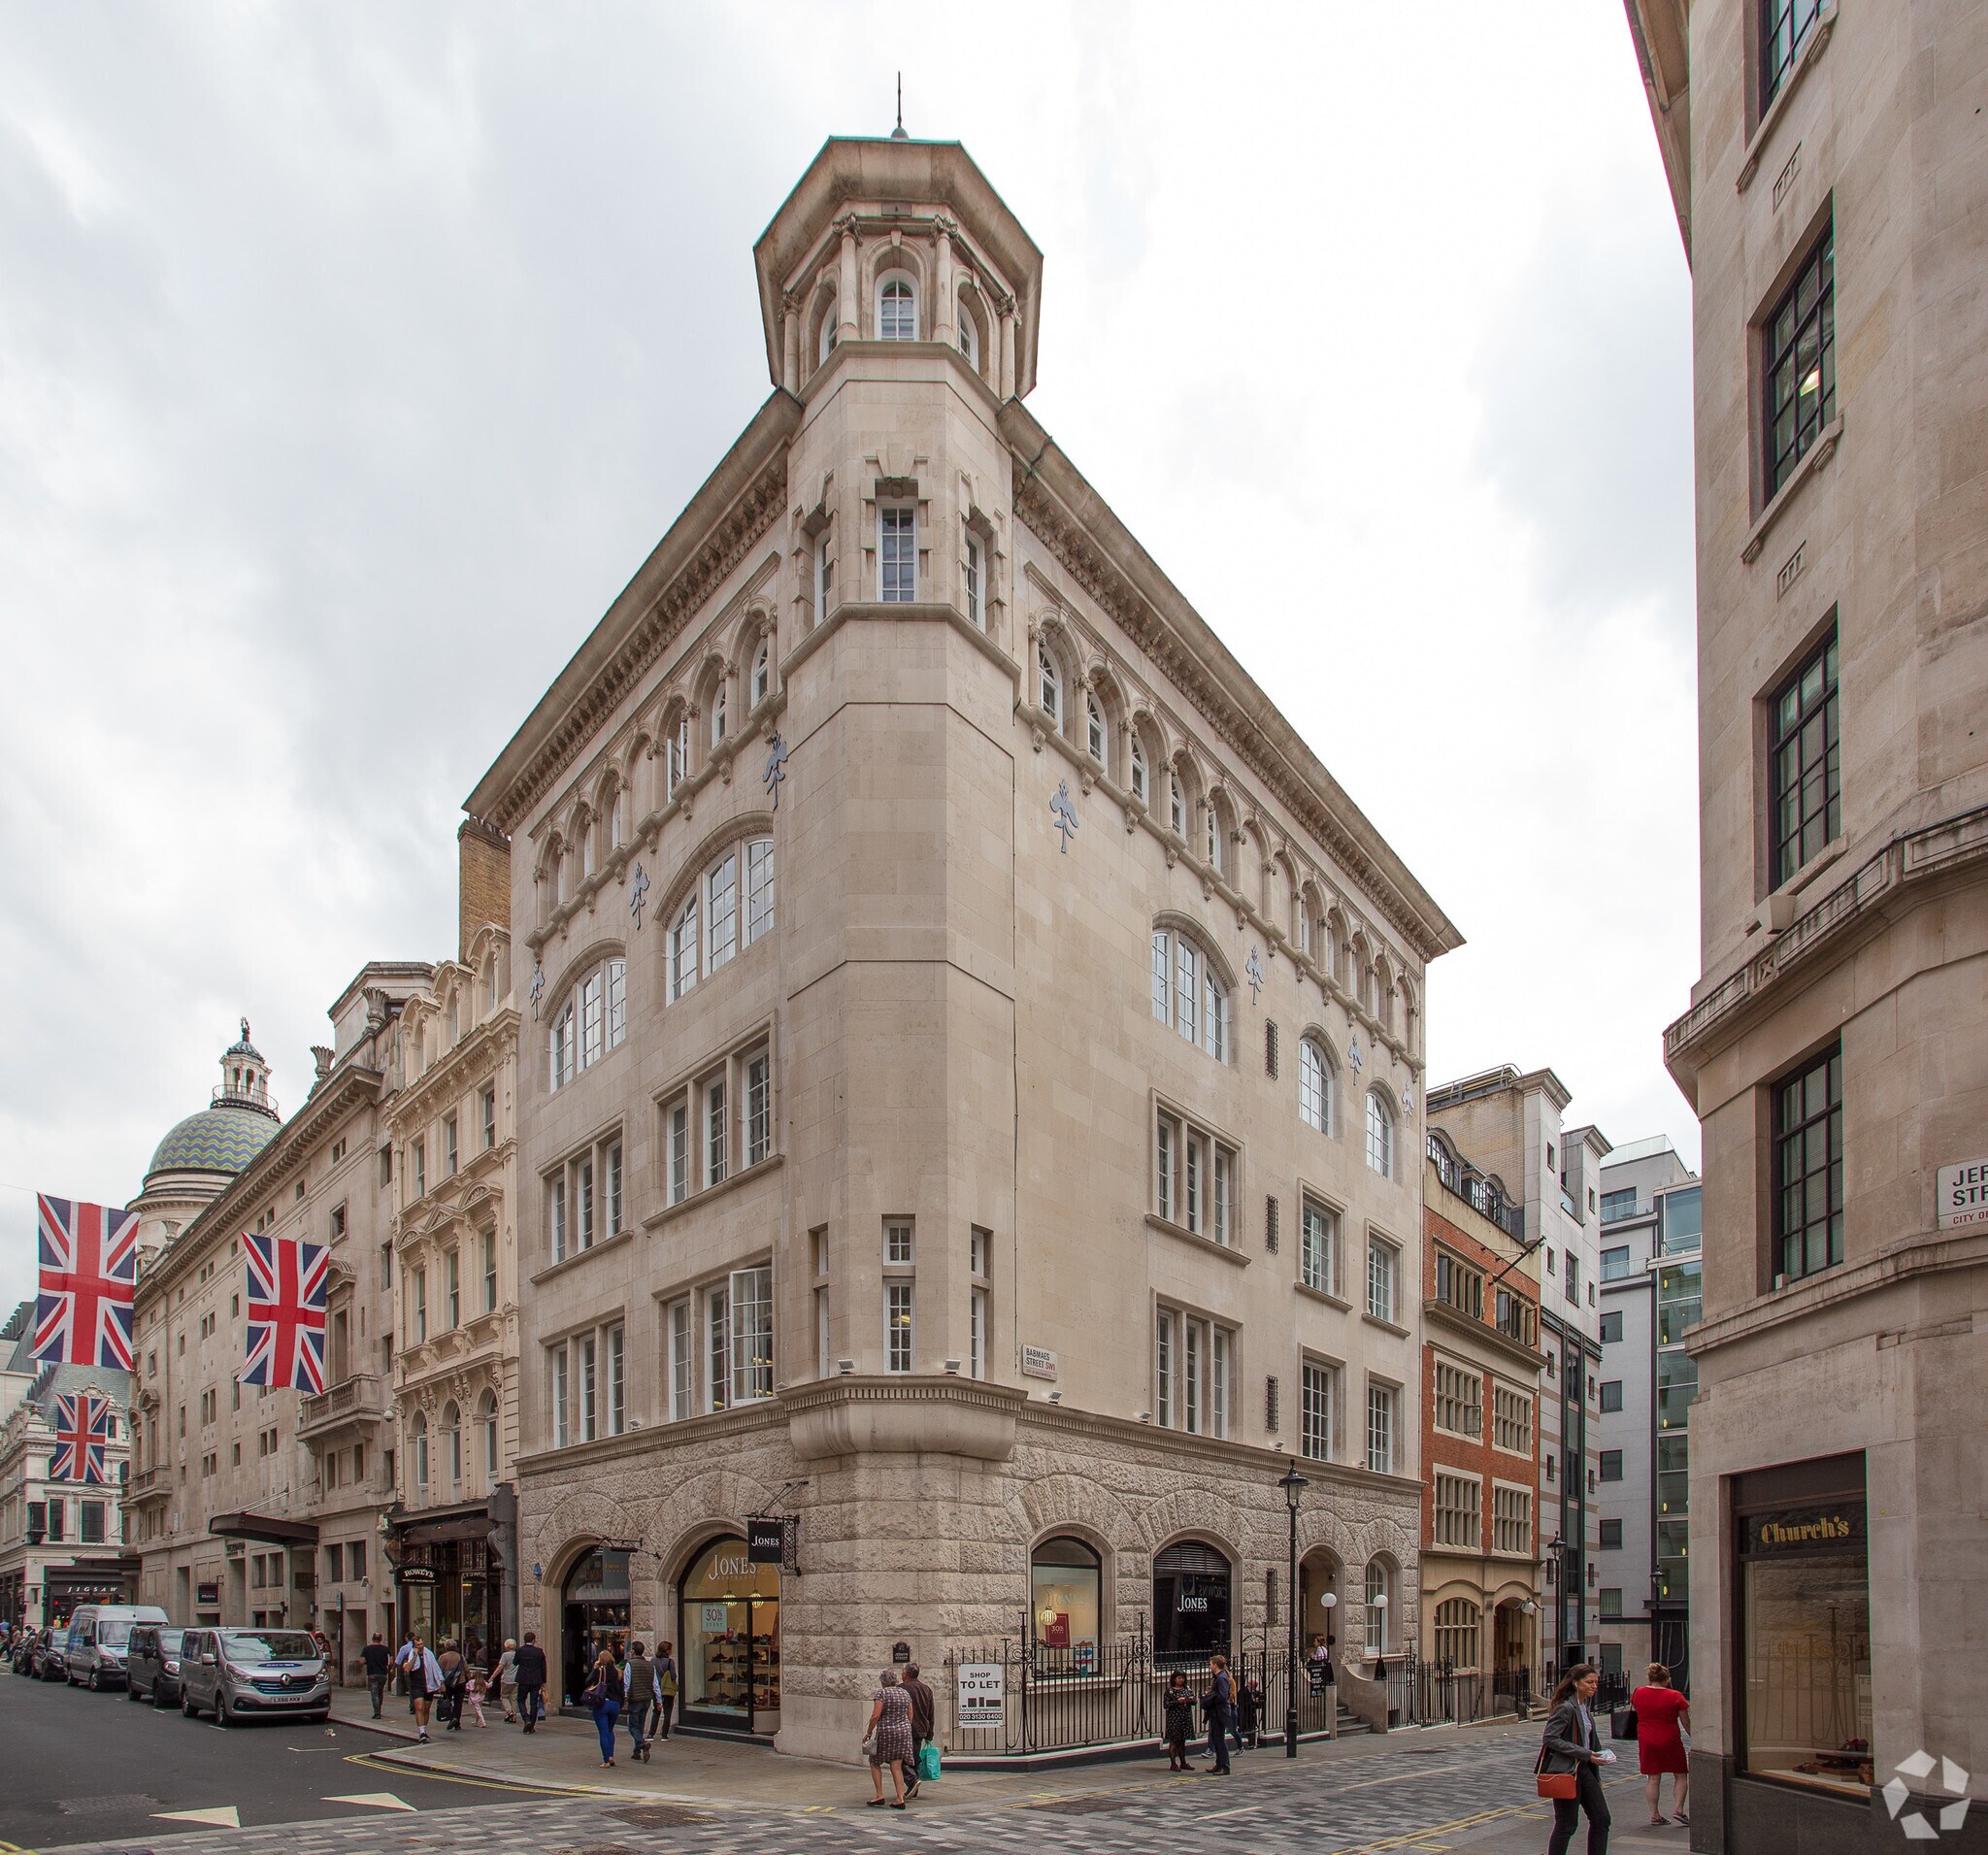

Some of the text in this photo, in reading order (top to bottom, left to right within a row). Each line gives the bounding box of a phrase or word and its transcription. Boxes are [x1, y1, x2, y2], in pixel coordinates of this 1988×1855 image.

[1953, 1213, 1973, 1225] CITY
[1026, 1347, 1050, 1361] BABMAES
[1025, 1357, 1044, 1368] STREET
[1761, 1515, 1849, 1543] Church's
[751, 1535, 779, 1546] JONES
[708, 1554, 756, 1580] JONES
[1176, 1594, 1208, 1612] JONES
[960, 1680, 1000, 1689] TO LET
